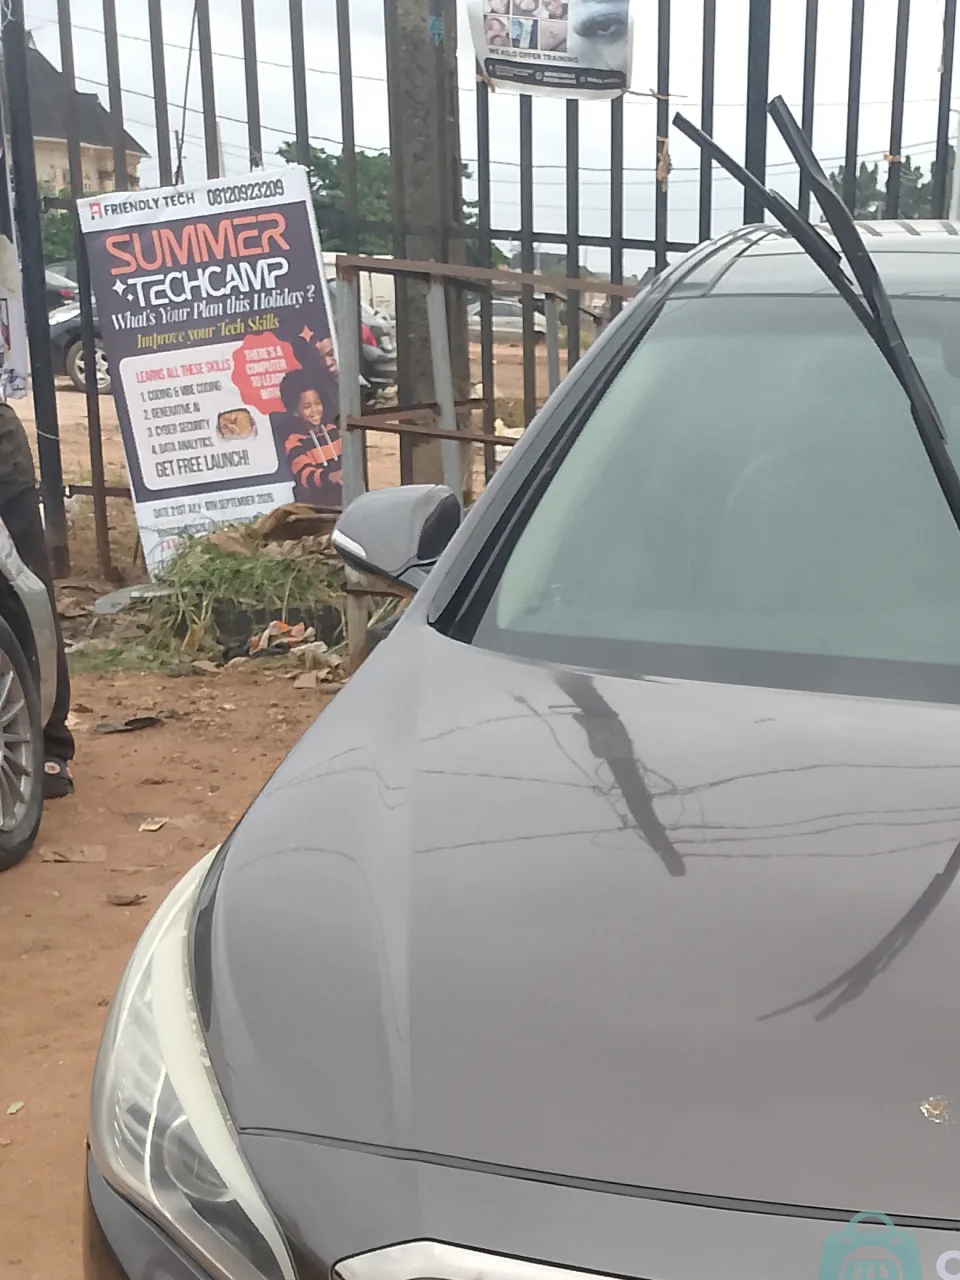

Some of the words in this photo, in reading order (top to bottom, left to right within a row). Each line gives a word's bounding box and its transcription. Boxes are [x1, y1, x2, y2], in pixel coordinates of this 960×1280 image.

[103, 197, 159, 216] FRIENDLY
[162, 192, 195, 208] TECH
[207, 179, 284, 206] 08120923209
[105, 212, 290, 275] SUMMER
[127, 256, 289, 307] TECHCAMP
[111, 308, 156, 331] What's
[159, 306, 190, 324] Your
[193, 300, 223, 320] Plan
[226, 295, 250, 315] this
[137, 330, 185, 349] Improve
[187, 327, 216, 344] your
[217, 319, 245, 337] Tech
[248, 313, 280, 332] Skills
[167, 366, 180, 379] ALL
[155, 461, 175, 478] GET
[177, 457, 203, 476] FREE
